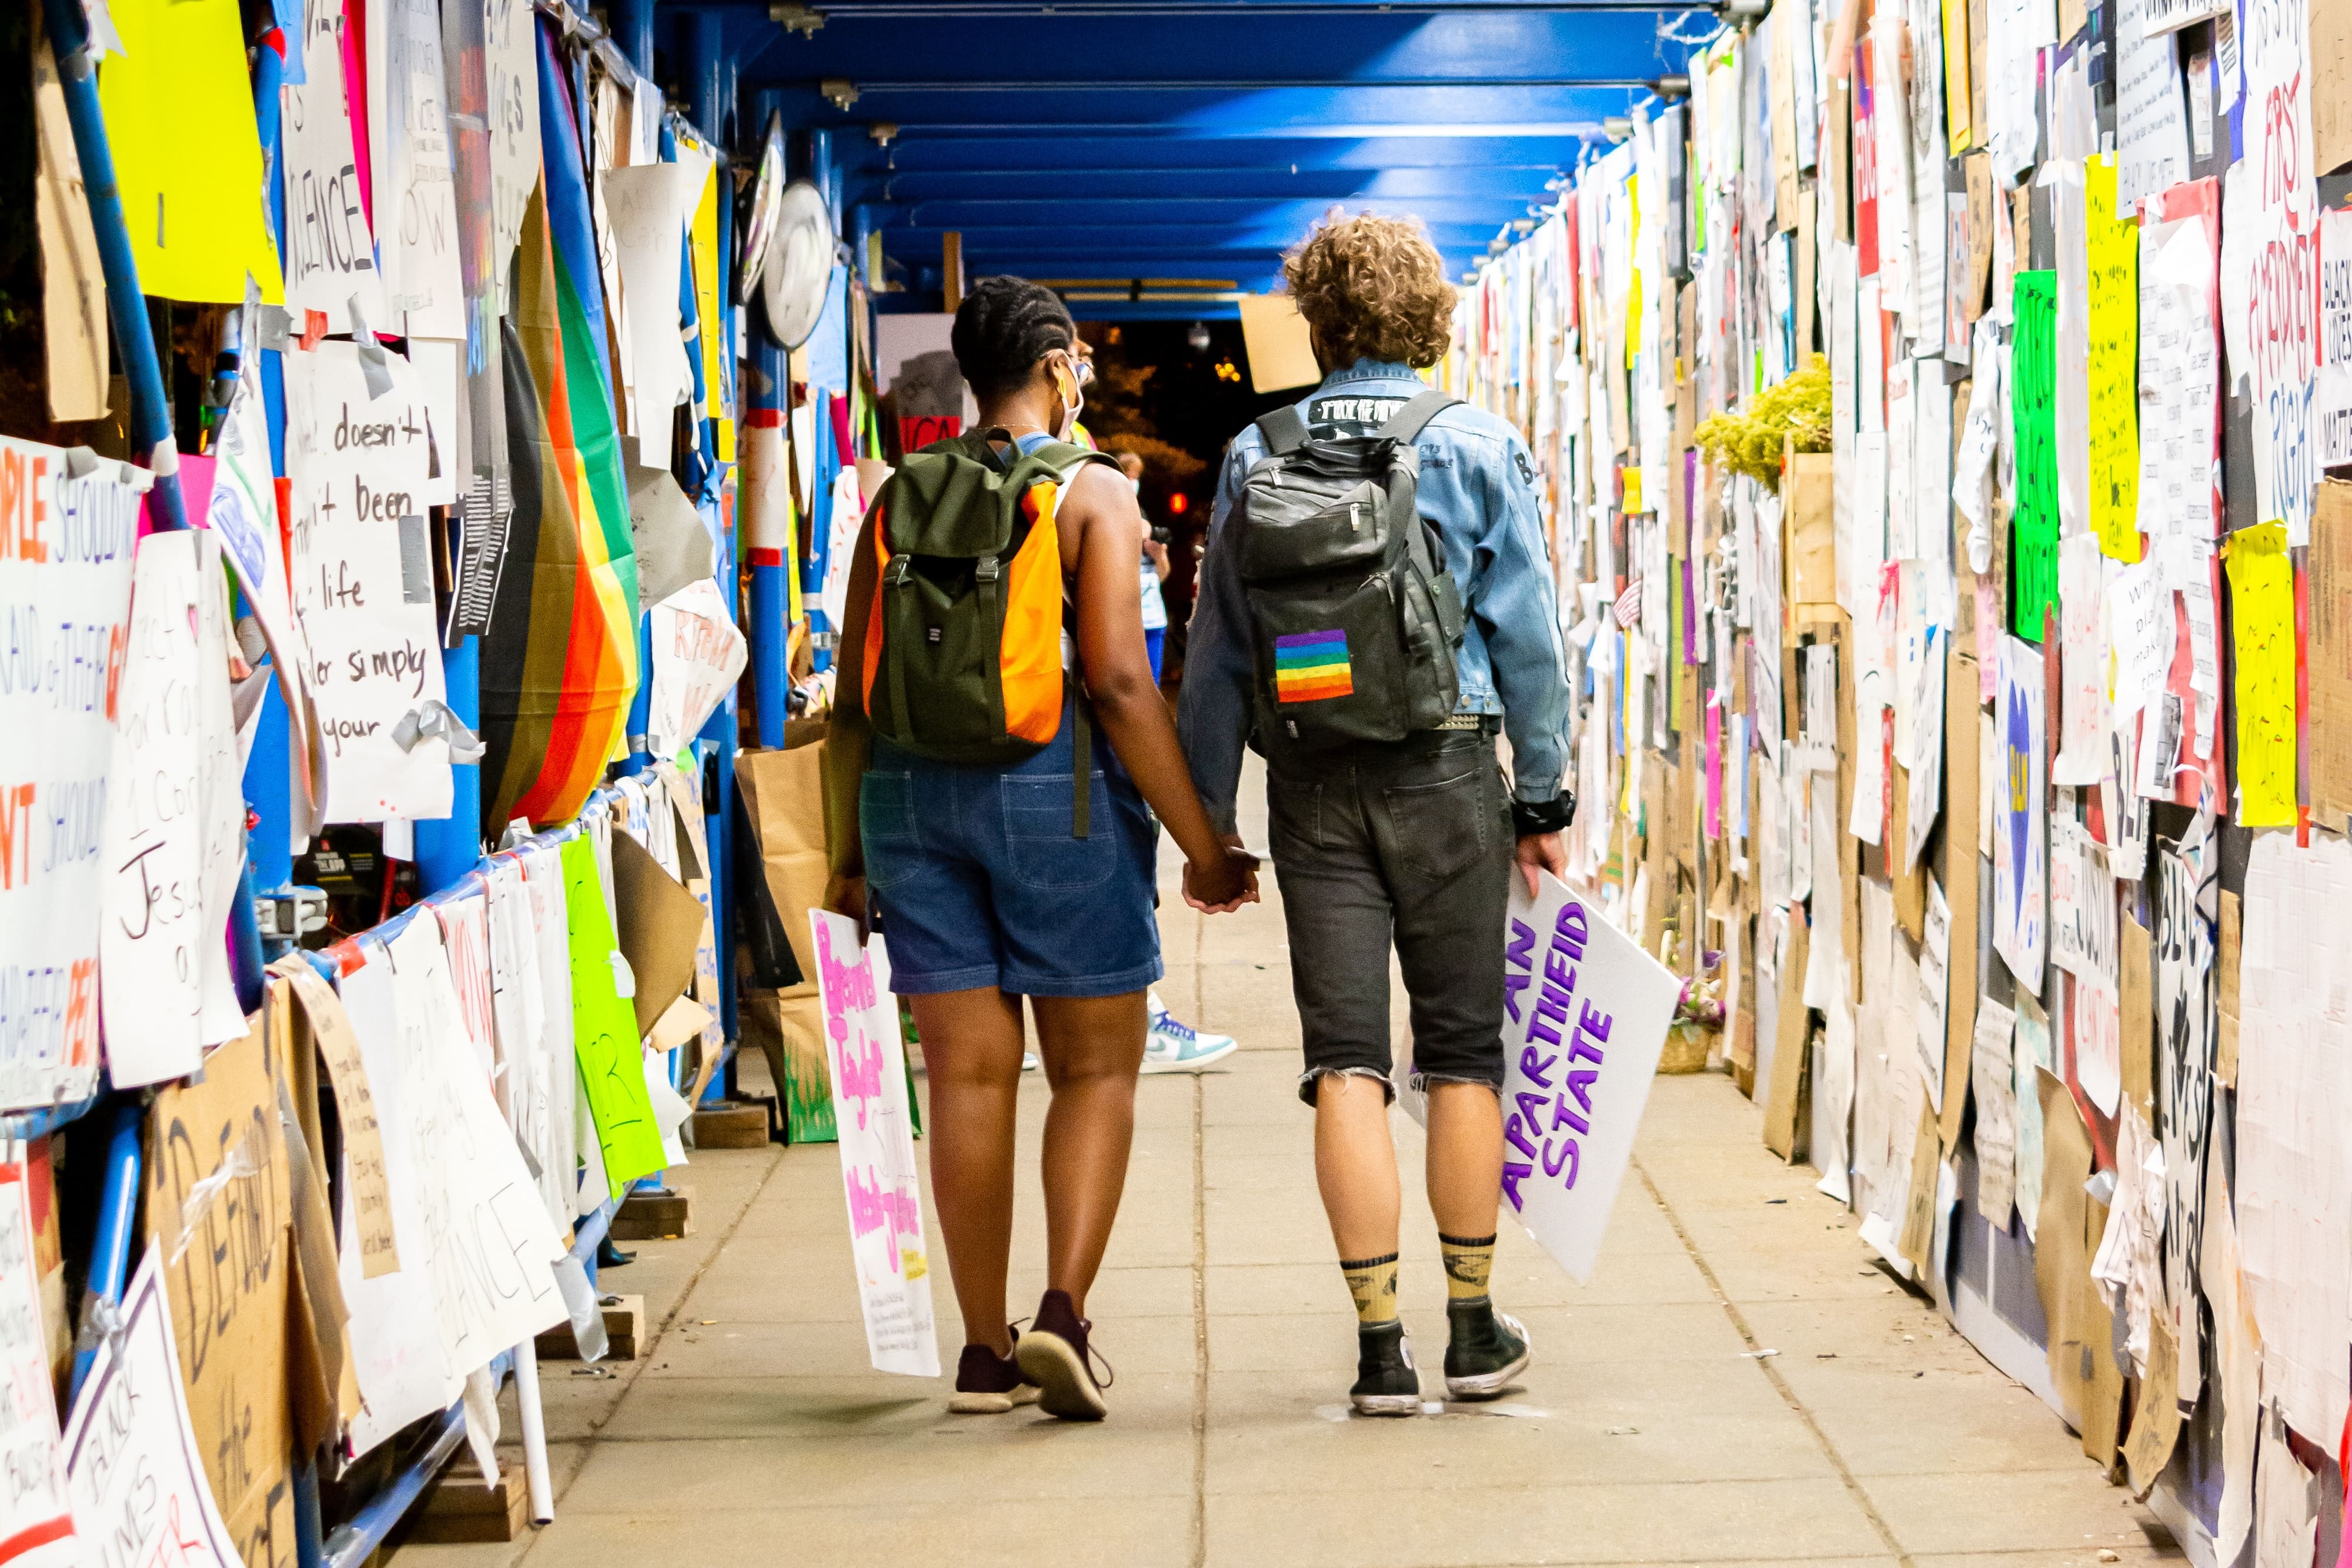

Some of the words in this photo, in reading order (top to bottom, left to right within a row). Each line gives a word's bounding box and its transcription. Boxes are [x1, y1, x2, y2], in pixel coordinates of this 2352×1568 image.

[335, 404, 423, 451] doesn't
[2270, 367, 2315, 526] RIGHT
[356, 475, 412, 522] been
[322, 560, 365, 610] life
[348, 638, 426, 699] simply
[323, 720, 380, 758] your
[1501, 901, 1589, 1213] APARTHEID
[1542, 998, 1612, 1190] STATE
